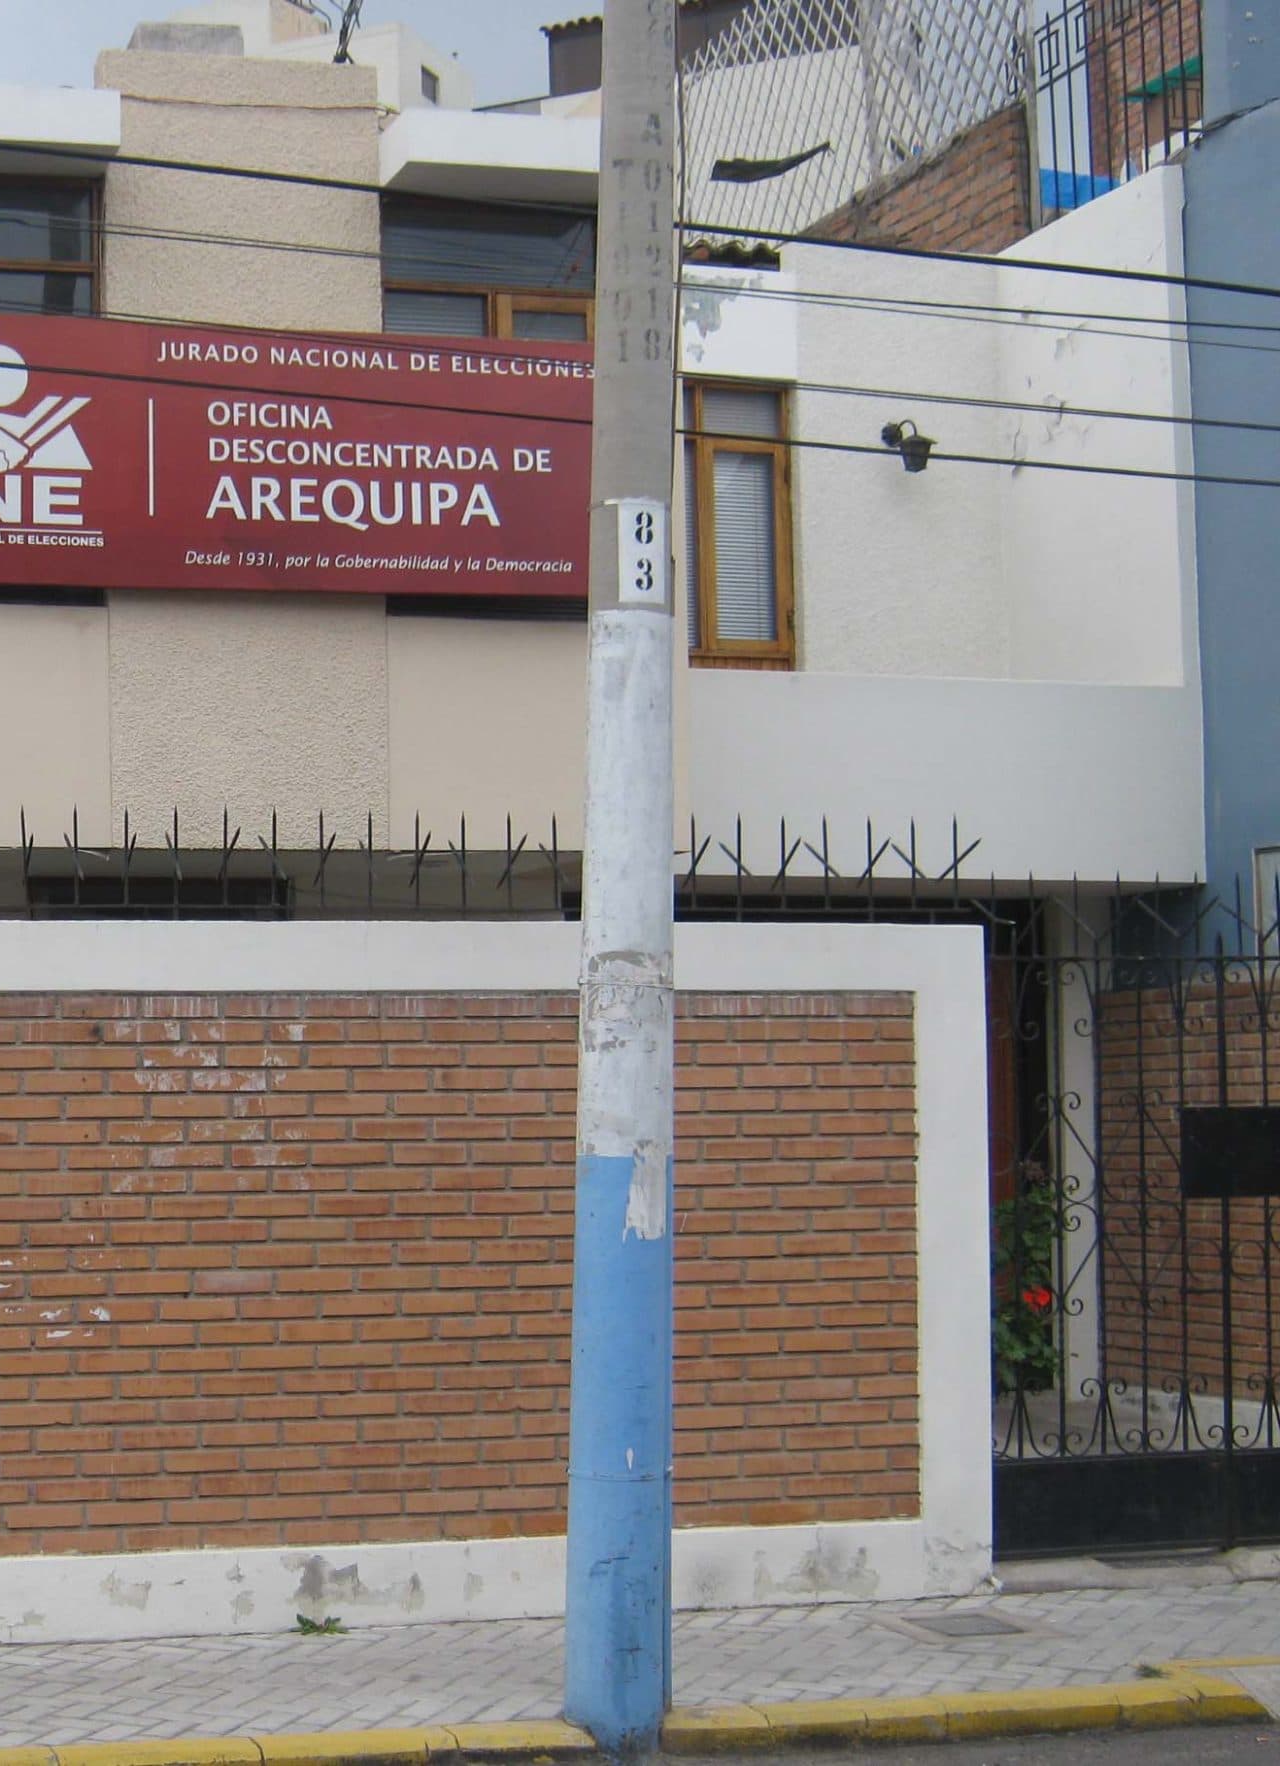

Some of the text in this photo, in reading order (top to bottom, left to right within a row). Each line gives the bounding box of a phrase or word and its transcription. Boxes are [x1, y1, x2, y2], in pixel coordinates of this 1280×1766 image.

[157, 341, 259, 364] JURADO
[270, 346, 400, 371] NACIONAL
[410, 353, 442, 373] DE
[207, 400, 333, 430] OFICINA
[209, 437, 553, 473] DESCONCENTRADA DE
[206, 475, 501, 532] AREQUIPA
[7, 534, 25, 545] DE
[27, 534, 104, 548] ELECCIONES
[635, 511, 653, 591] 83
[185, 550, 231, 566] Desde
[285, 556, 312, 570] por
[316, 553, 330, 569] la
[334, 554, 450, 572] Gobernabilidad
[453, 559, 464, 574] y
[467, 556, 481, 572] la
[485, 557, 573, 574] Democracia
